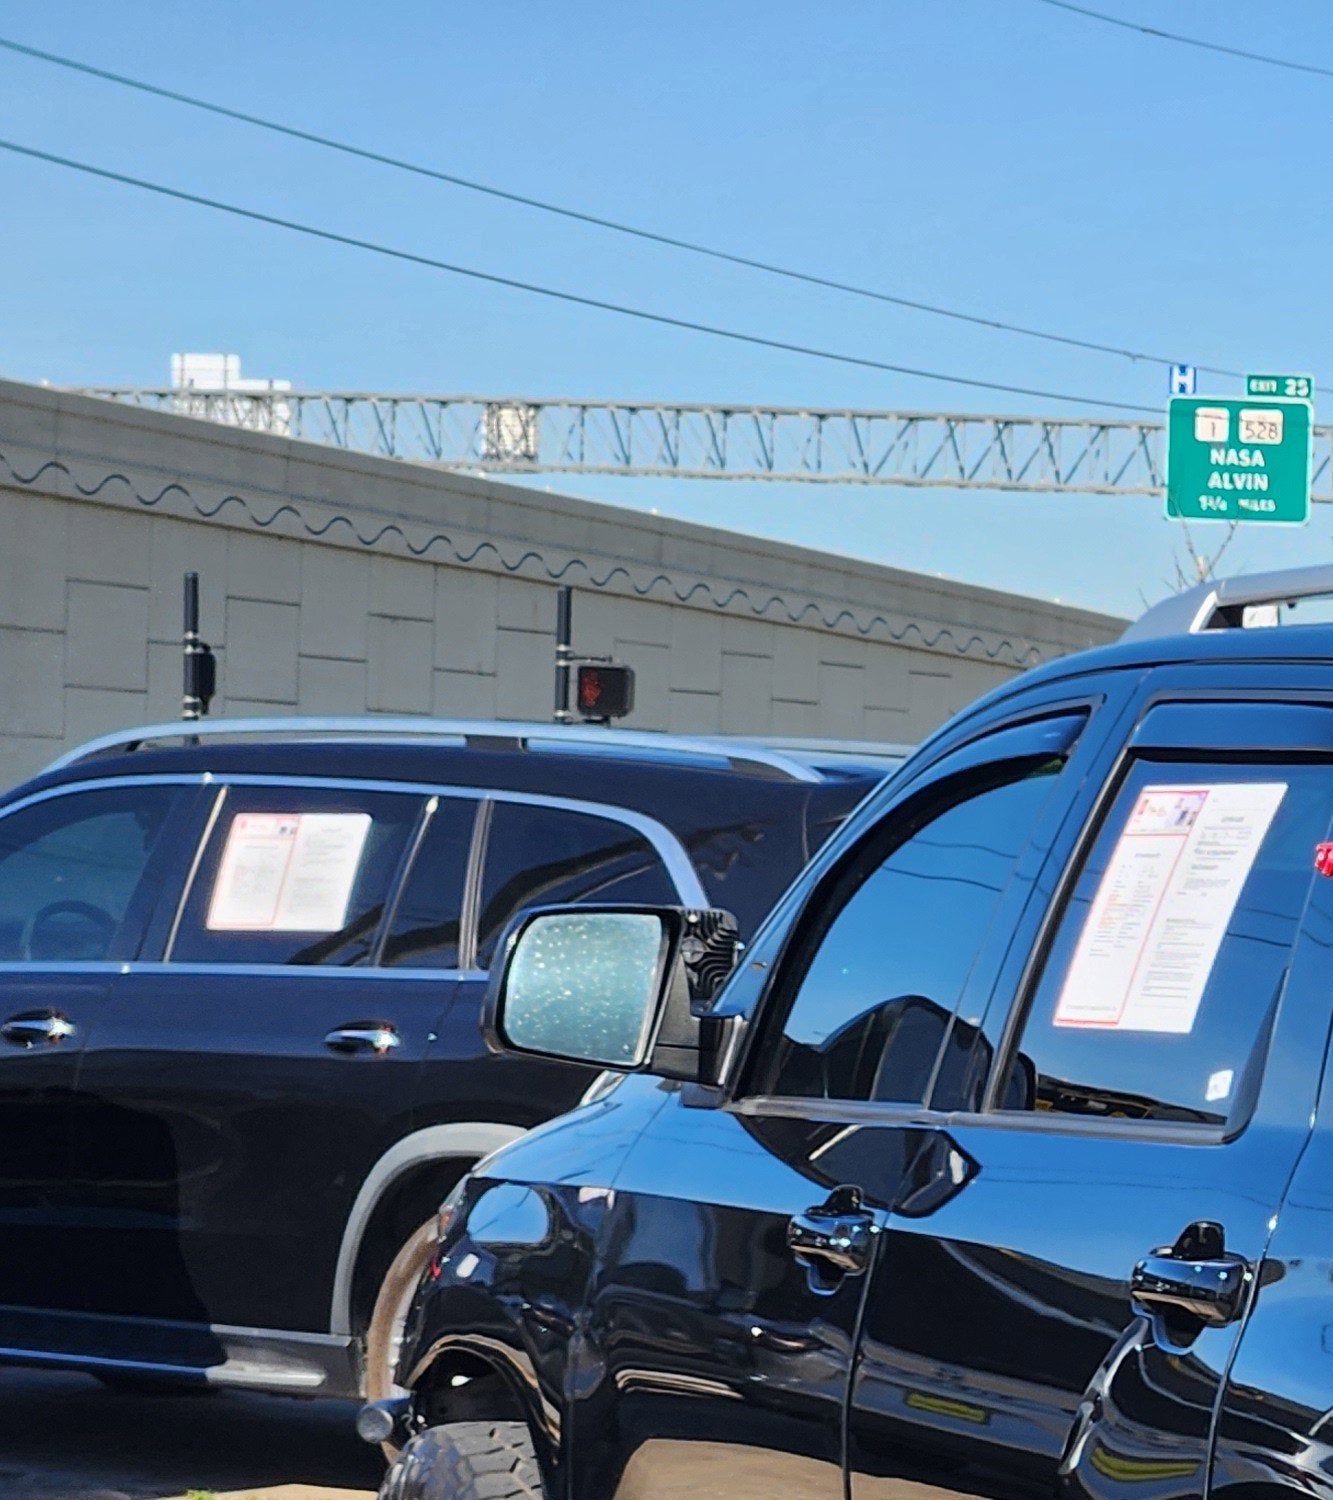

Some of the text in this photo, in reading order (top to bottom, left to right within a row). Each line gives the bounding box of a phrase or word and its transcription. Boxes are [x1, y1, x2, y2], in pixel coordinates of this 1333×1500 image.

[1285, 378, 1309, 396] 23
[1245, 420, 1278, 440] 528
[1210, 448, 1265, 467] NASA
[1207, 471, 1269, 491] ALVIN
